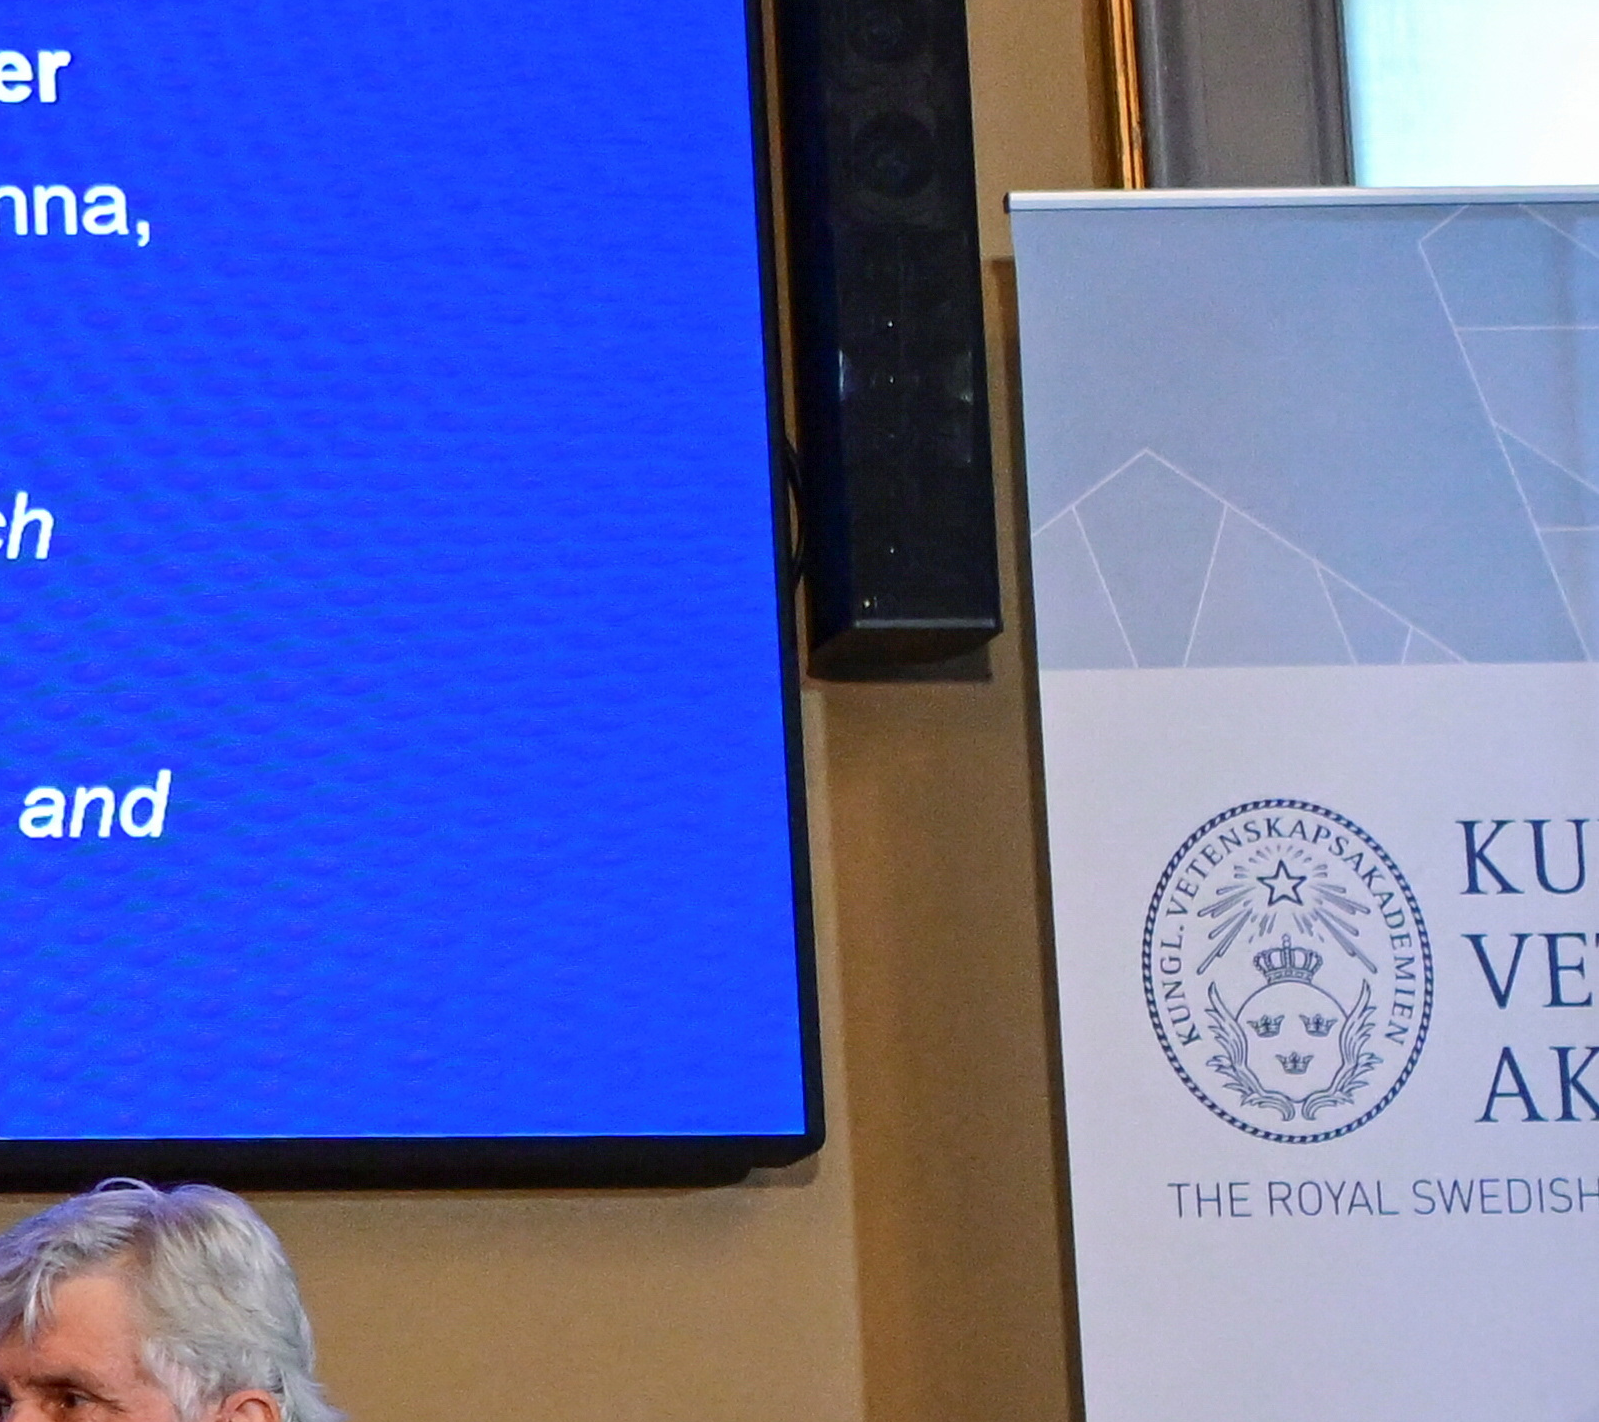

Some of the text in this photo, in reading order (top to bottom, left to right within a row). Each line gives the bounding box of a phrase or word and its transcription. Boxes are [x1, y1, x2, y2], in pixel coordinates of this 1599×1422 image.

[20, 770, 171, 837] and
[1160, 816, 1418, 1047] KUNGL. VETENSKAPSAKADEMIEN
[1168, 1182, 1251, 1218] THE
[1268, 1180, 1399, 1216] ROYAL
